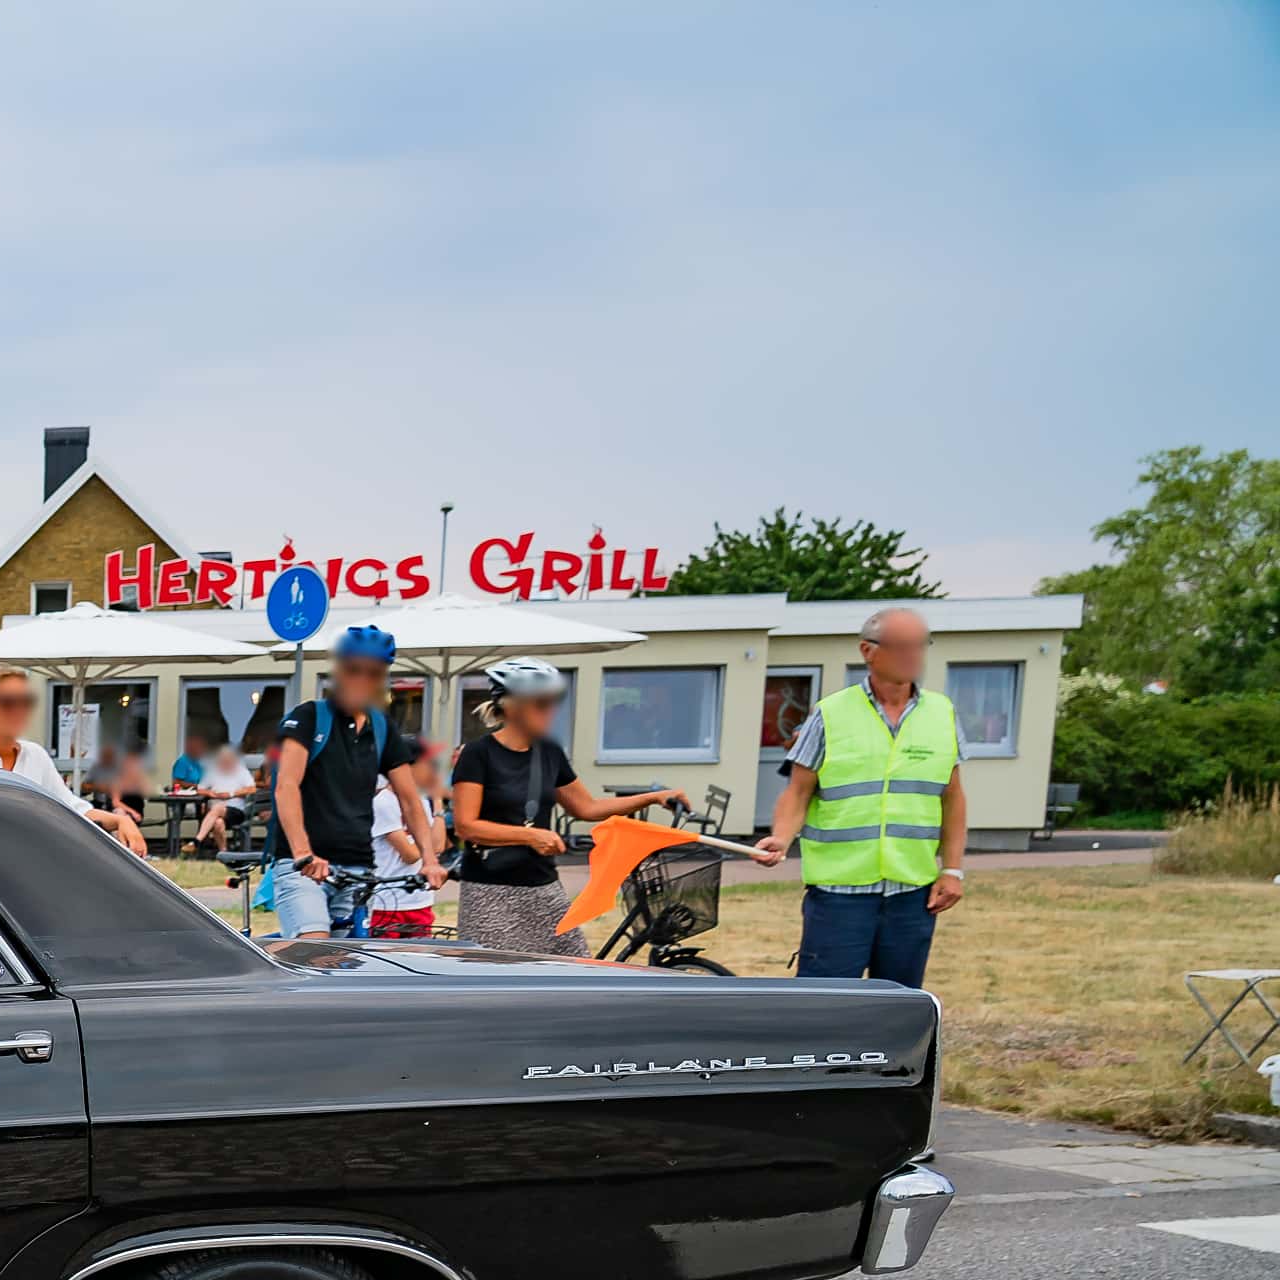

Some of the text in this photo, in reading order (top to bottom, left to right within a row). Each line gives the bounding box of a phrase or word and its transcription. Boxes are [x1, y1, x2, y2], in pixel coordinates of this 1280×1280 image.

[104, 525, 670, 609] HERTNGS GRILL
[524, 1051, 887, 1079] FAIRLANE 500
